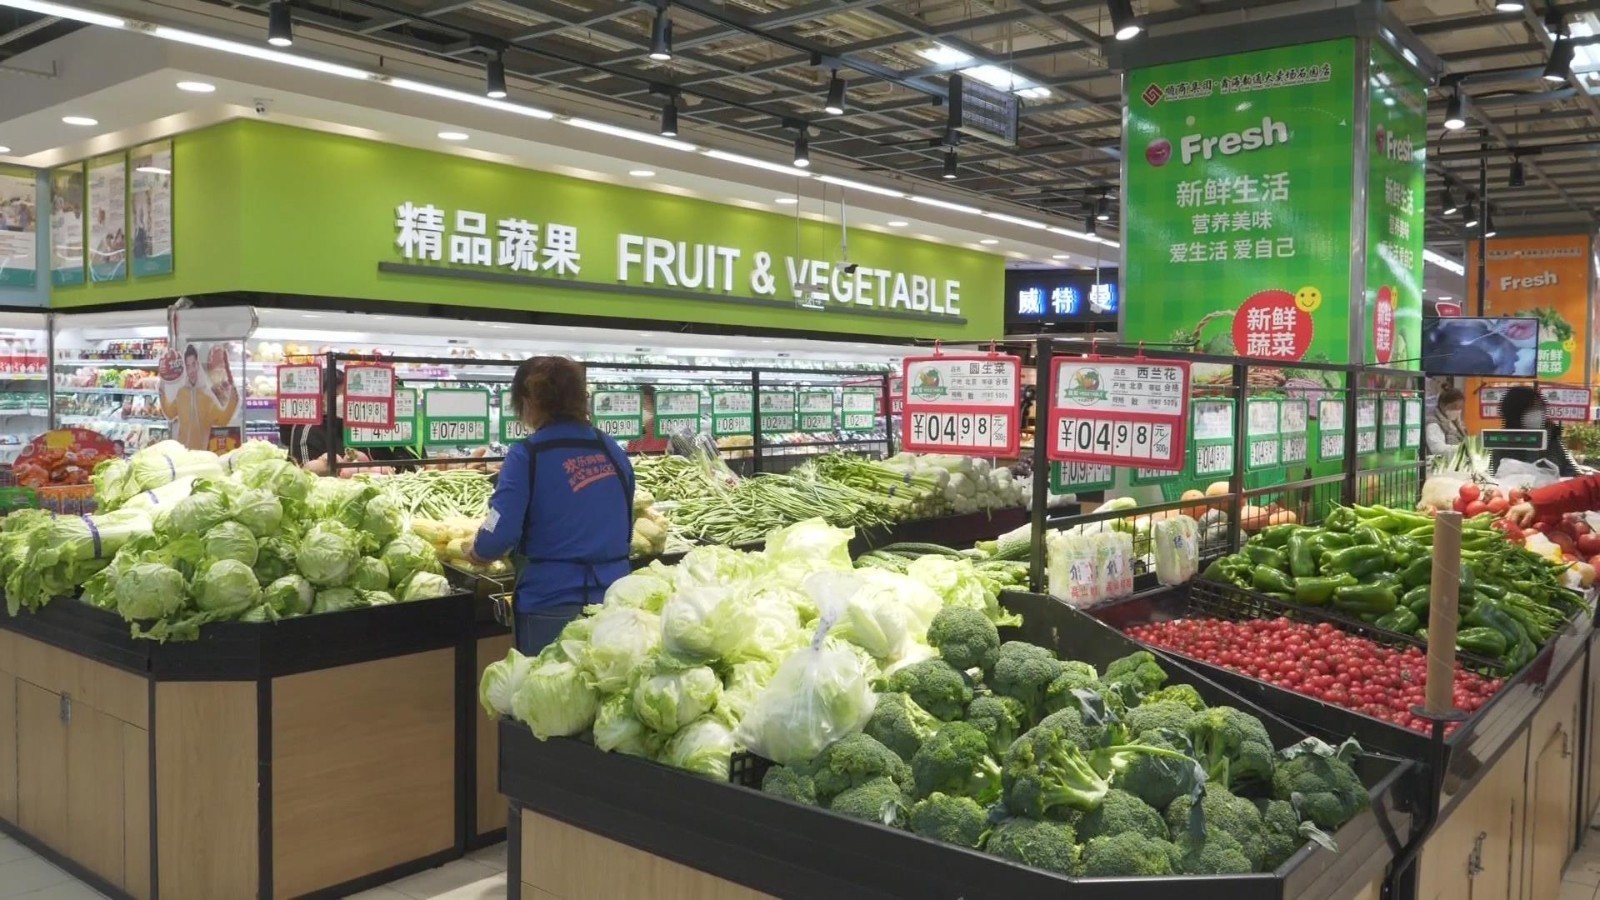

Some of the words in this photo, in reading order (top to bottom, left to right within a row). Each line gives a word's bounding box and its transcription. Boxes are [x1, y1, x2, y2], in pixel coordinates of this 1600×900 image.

[1180, 116, 1288, 165] Fresh
[1386, 130, 1414, 161] Fresh
[1176, 172, 1290, 208] 新鲜生活
[1192, 209, 1273, 235] 营养美味
[394, 201, 581, 276] 精品蔬果
[1169, 242, 1228, 263] 爱生活
[1233, 237, 1296, 260] 爱自己
[616, 233, 741, 291] FRUIT
[750, 251, 777, 296] &
[784, 256, 961, 315] VEGETABLE
[1500, 270, 1558, 292] Fresh
[1247, 306, 1297, 331] 新鲜
[1247, 332, 1296, 357] 蔬菜
[1136, 366, 1176, 380] 西兰花
[1060, 420, 1147, 451] ¥04.98
